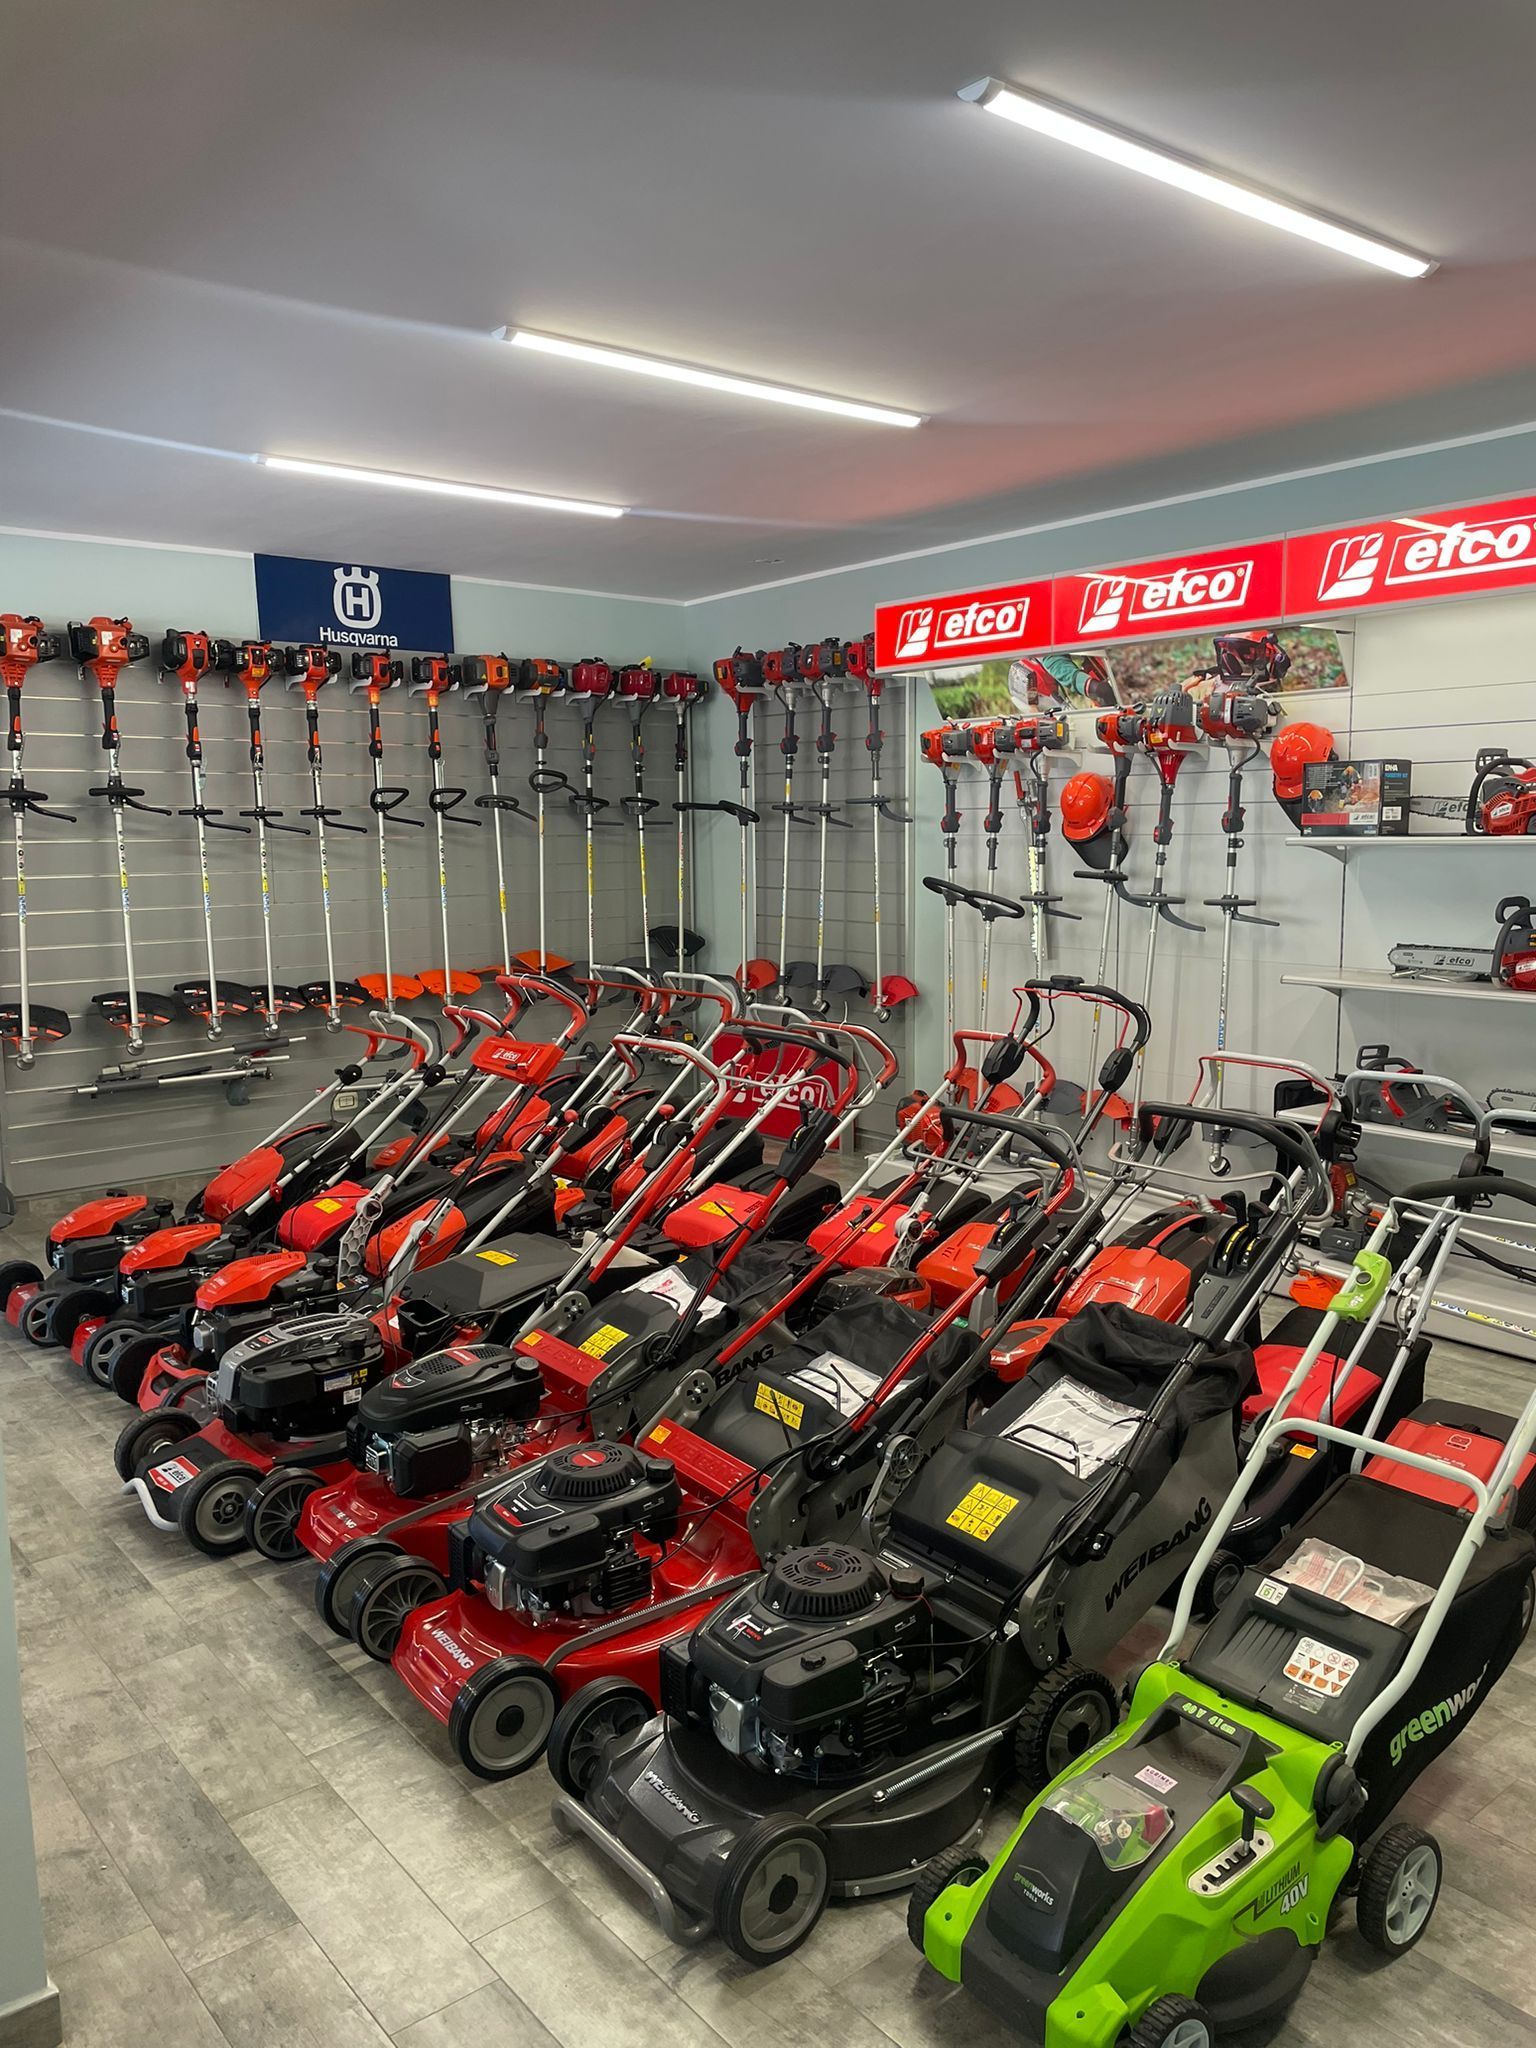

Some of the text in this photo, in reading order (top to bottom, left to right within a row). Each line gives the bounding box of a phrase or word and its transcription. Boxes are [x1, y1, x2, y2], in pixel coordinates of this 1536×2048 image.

[1403, 521, 1532, 572] efco
[1140, 567, 1237, 611] efco
[319, 626, 398, 647] Husqvarna
[943, 602, 1019, 639] efco
[1449, 957, 1472, 965] efco
[715, 1344, 775, 1390] BANG
[1105, 1496, 1212, 1613] WEIBANG
[431, 1628, 475, 1669] WEIBANG
[645, 1770, 700, 1825] WEIBANG
[1013, 1871, 1054, 1906] greenworks
[1280, 1872, 1310, 1916] 40V
